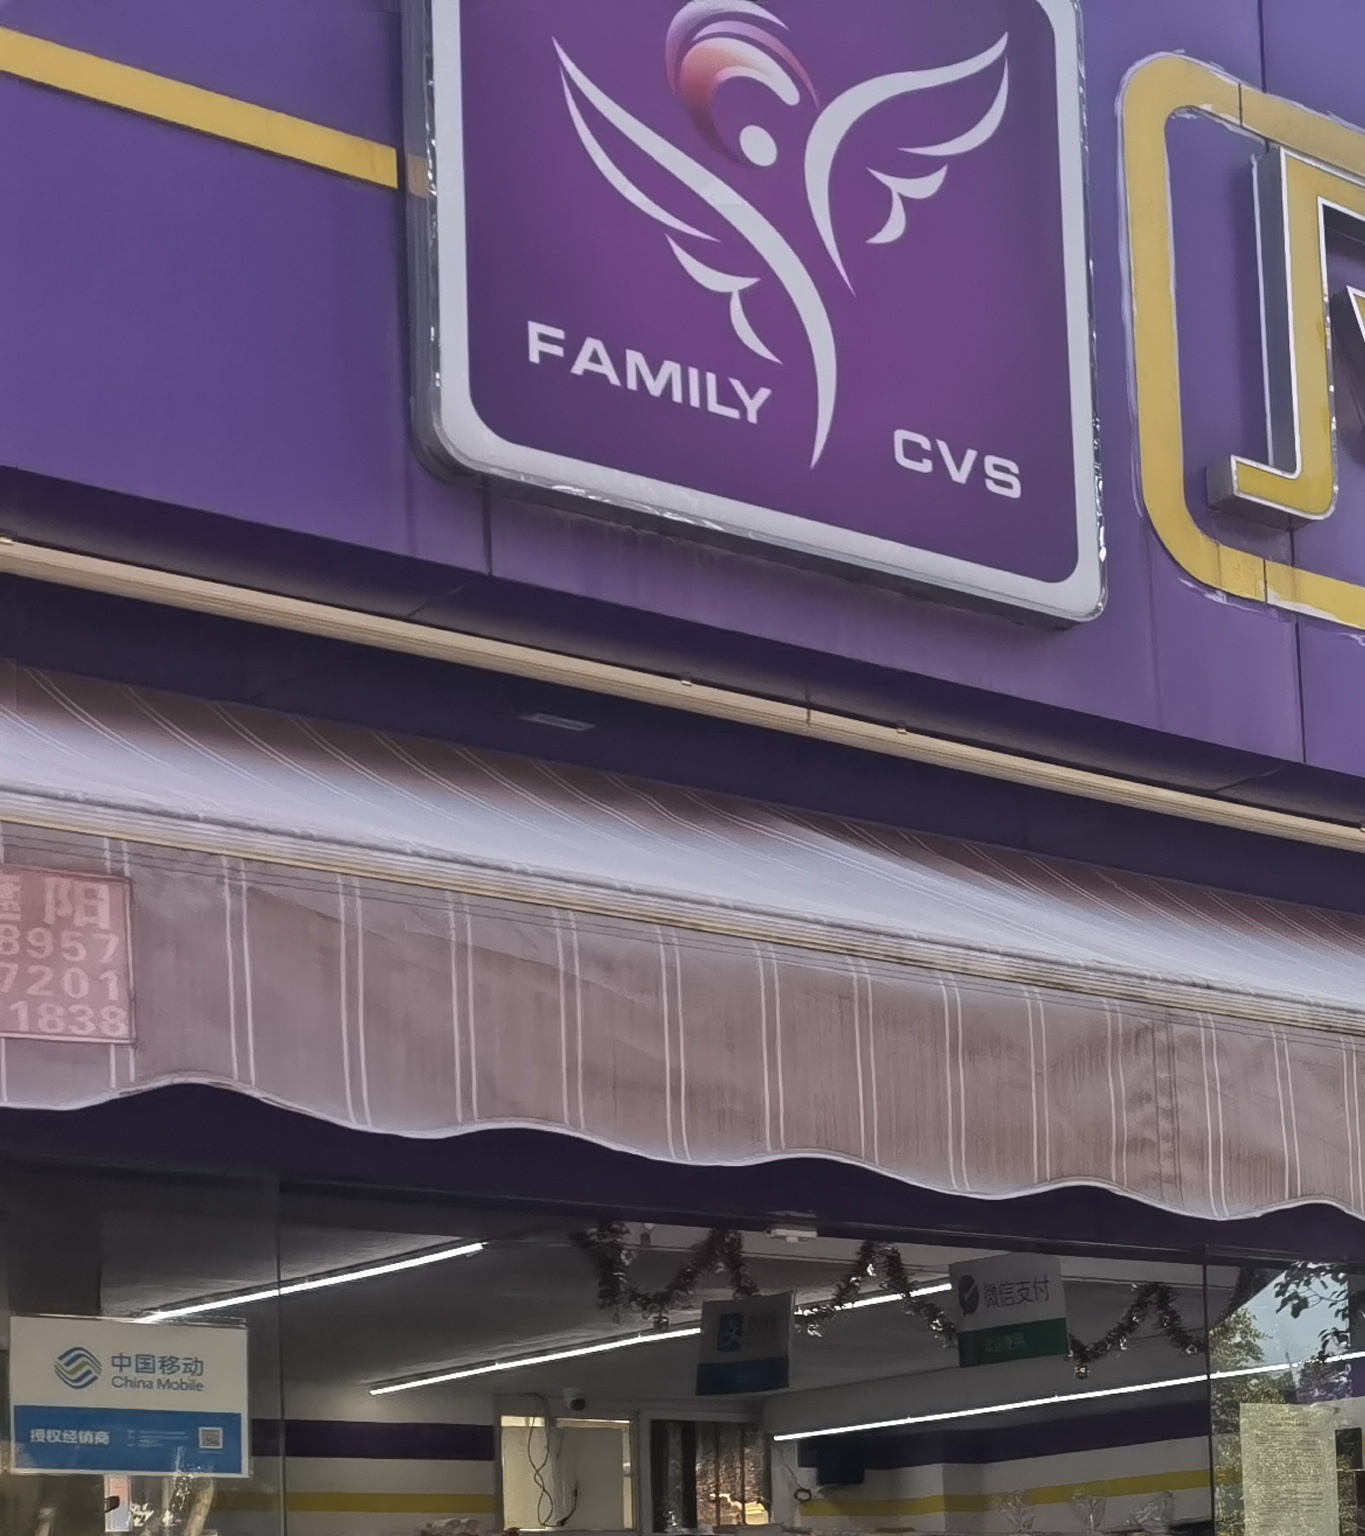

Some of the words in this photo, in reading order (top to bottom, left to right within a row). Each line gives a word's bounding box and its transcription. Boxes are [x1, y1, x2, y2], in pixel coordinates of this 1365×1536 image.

[527, 321, 771, 424] FAMILY
[893, 429, 1022, 499] CVS
[9, 1000, 128, 1036] 1838
[111, 1352, 204, 1377] 中国移动
[111, 1375, 154, 1390] China
[156, 1377, 204, 1392] Mobile
[30, 1428, 110, 1445] 授权经销商
